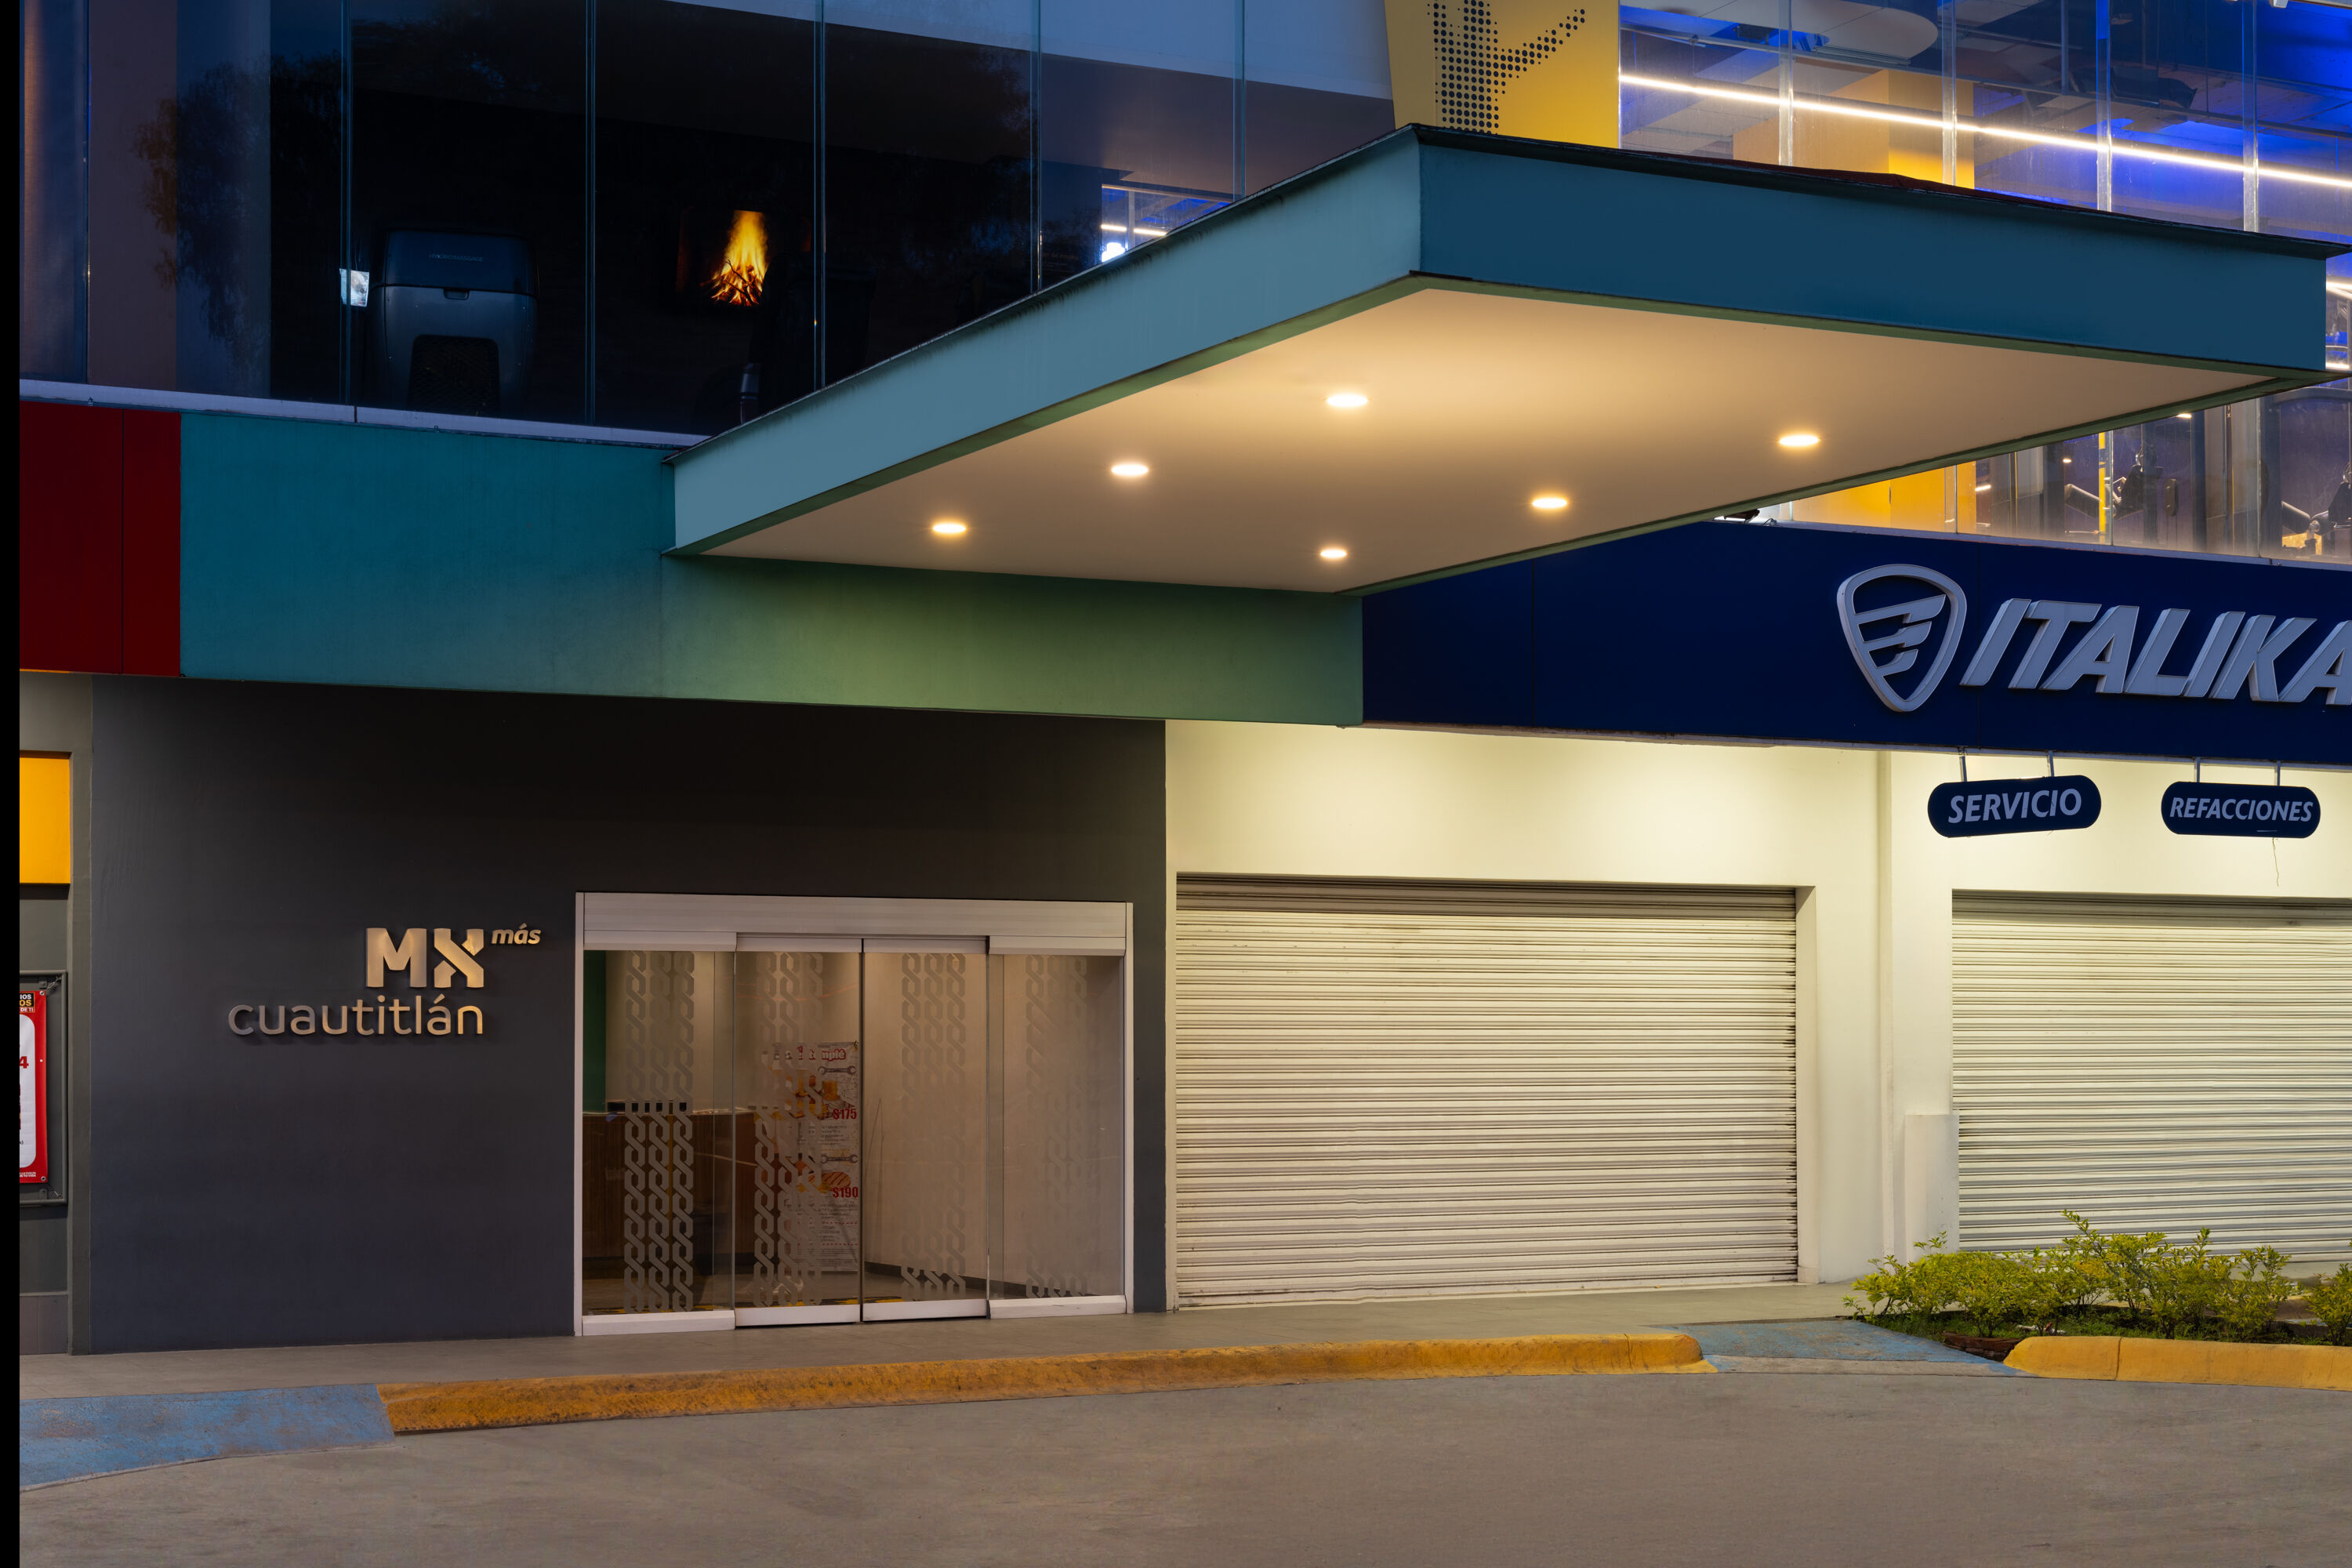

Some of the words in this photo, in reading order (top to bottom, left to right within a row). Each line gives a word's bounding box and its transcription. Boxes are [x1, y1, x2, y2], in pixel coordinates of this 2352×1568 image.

[1959, 597, 2352, 705] ITALIKA
[1947, 787, 2082, 824] SERVICIO
[2169, 797, 2314, 822] REFACCIONES
[366, 927, 484, 988] MX
[491, 923, 542, 945] más
[228, 993, 483, 1036] cuautitlán
[833, 1109, 857, 1120] $175
[833, 1186, 858, 1198] $190
